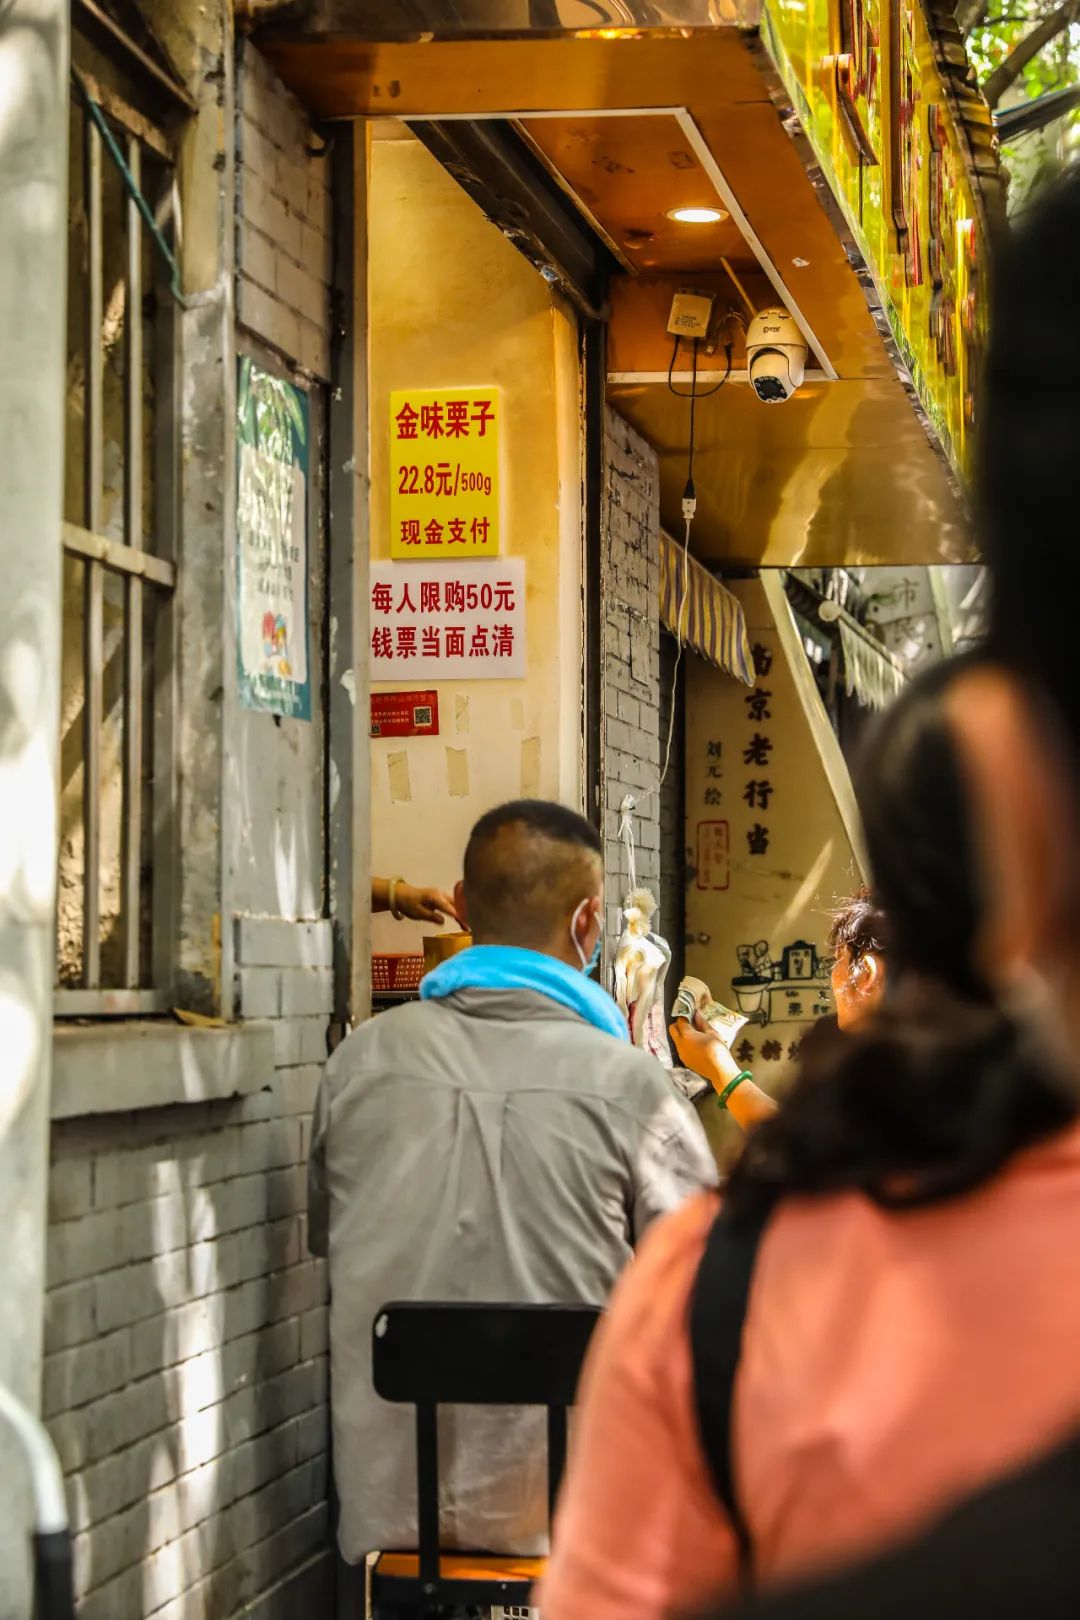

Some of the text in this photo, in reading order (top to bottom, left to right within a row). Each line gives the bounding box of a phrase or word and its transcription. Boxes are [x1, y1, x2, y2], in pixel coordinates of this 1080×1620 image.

[395, 401, 495, 439] 金味栗子
[398, 463, 492, 497] 22.8元/500g
[400, 517, 490, 545] 现金支付
[371, 581, 515, 614] 每人限购50元
[371, 624, 514, 659] 钱票当面点清
